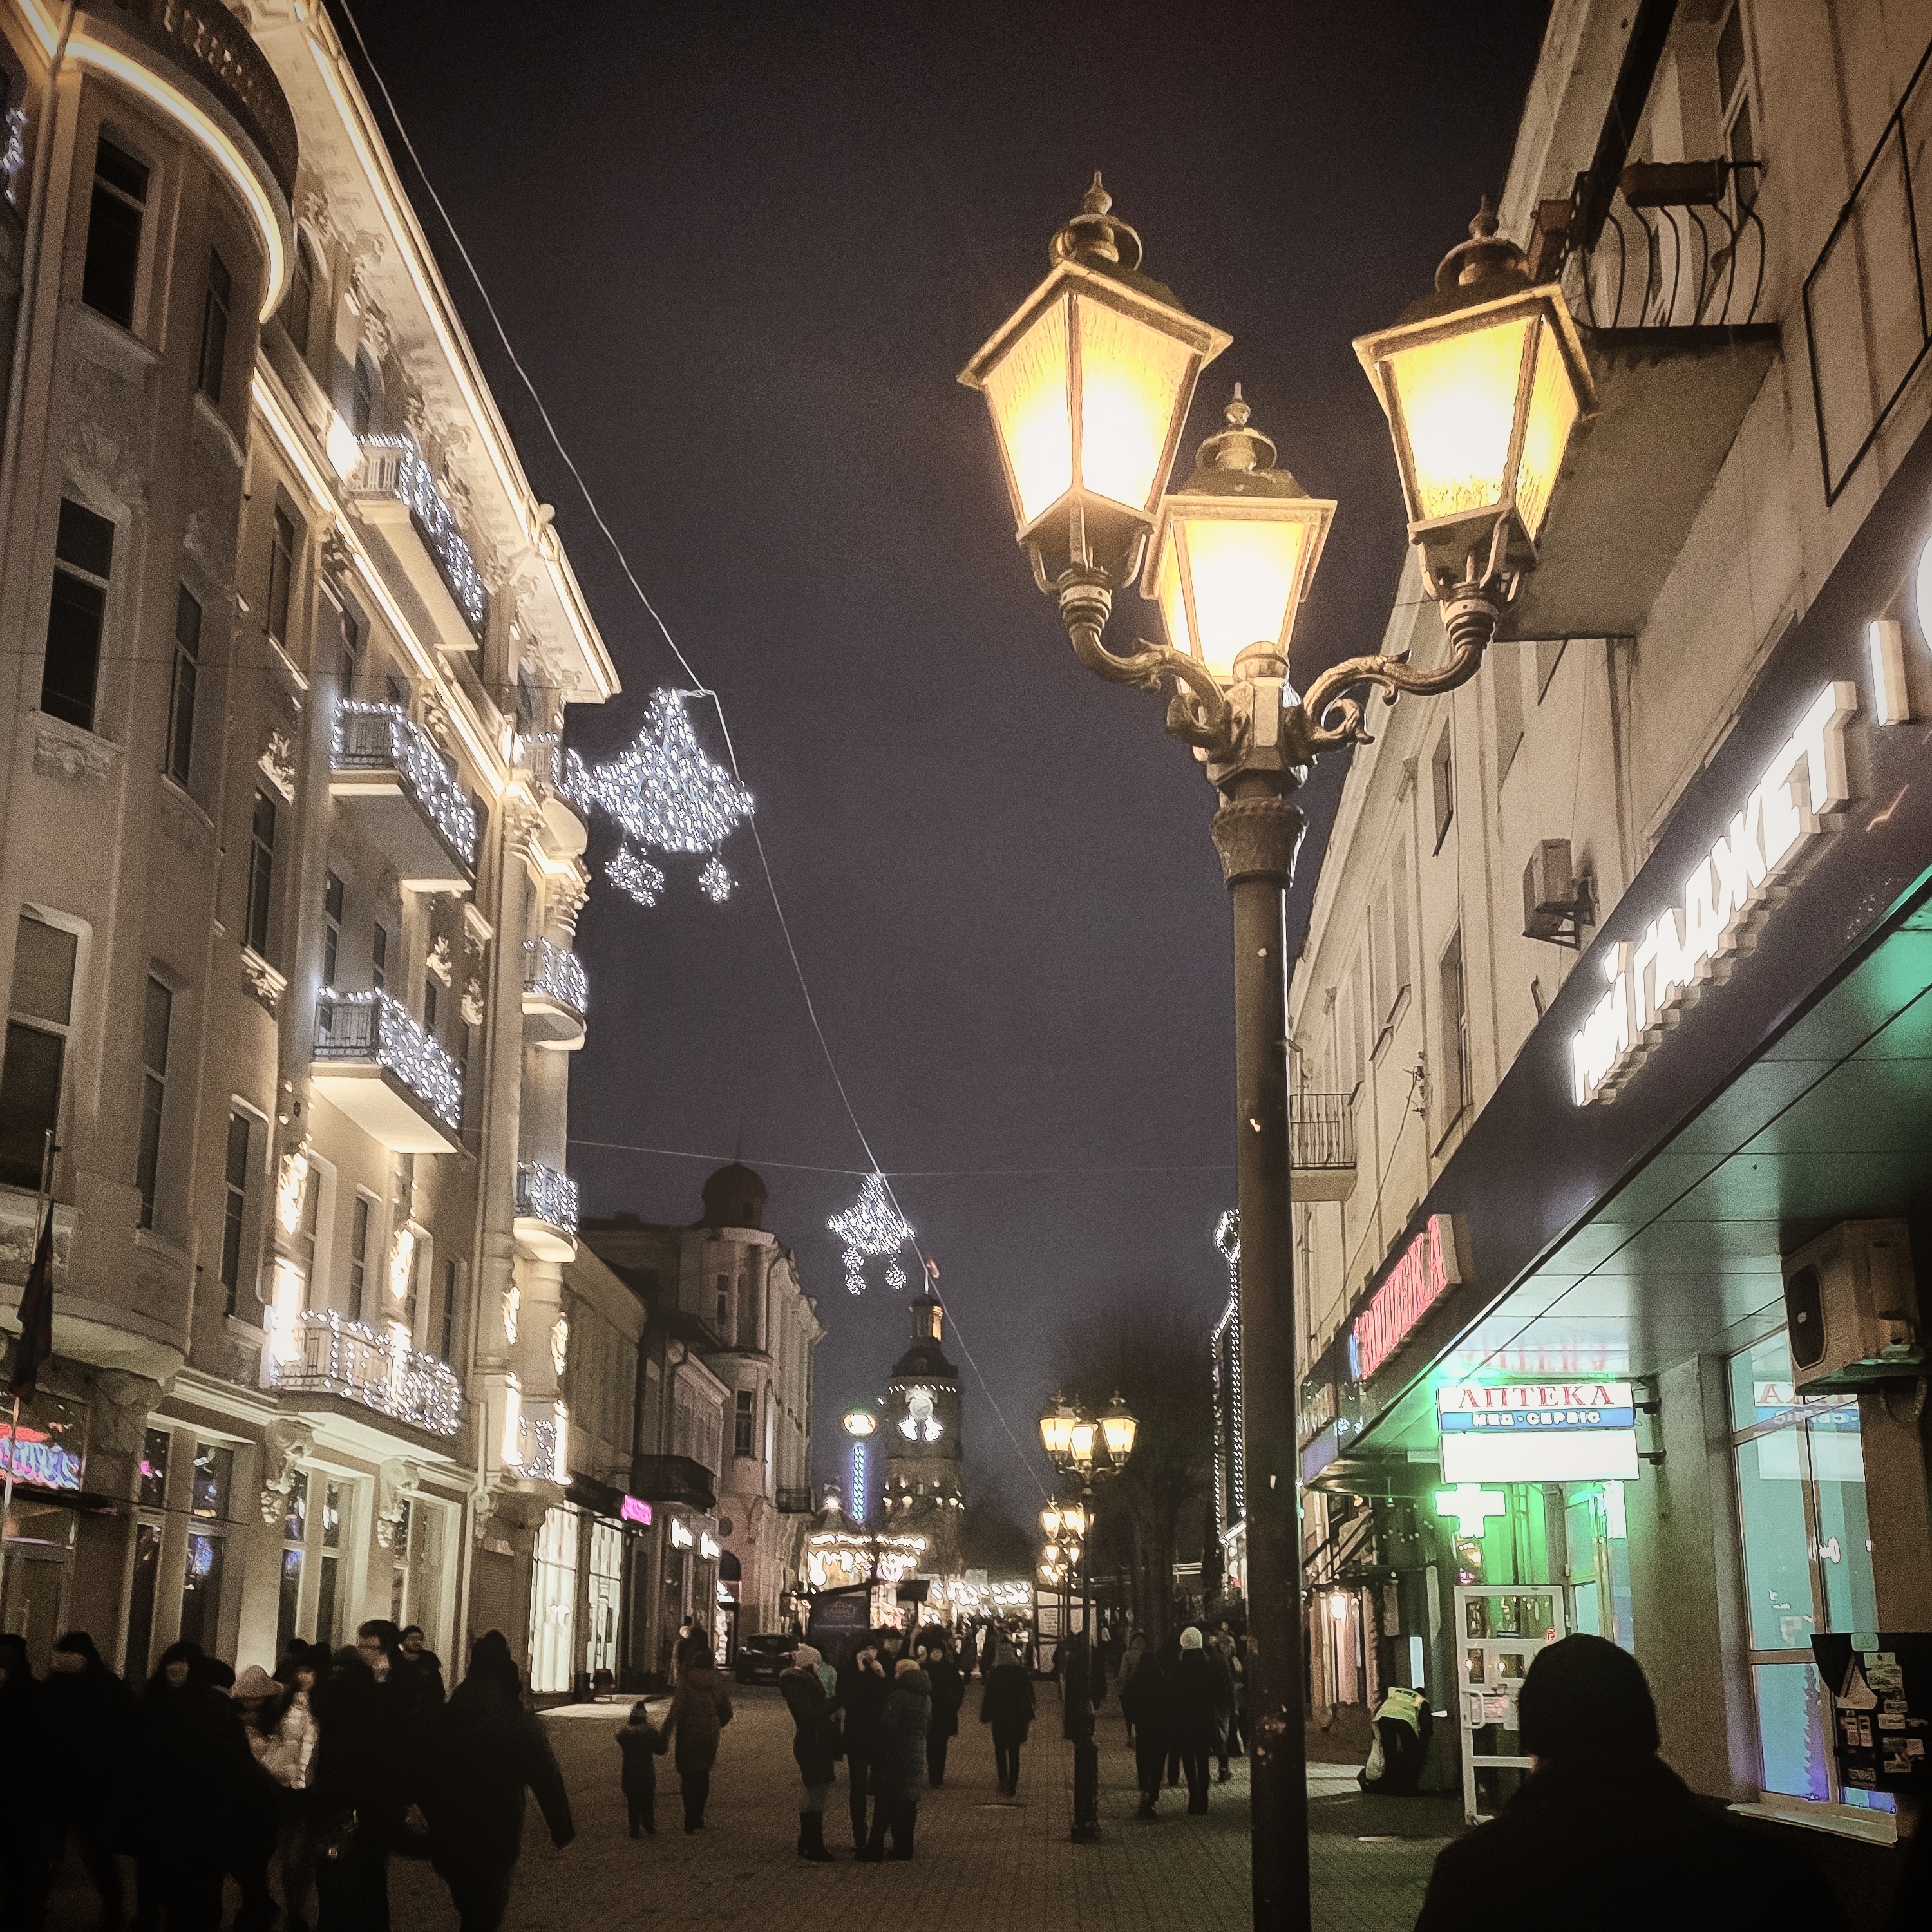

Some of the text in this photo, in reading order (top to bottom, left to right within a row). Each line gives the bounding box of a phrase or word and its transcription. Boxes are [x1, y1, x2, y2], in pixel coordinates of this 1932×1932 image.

[1633, 681, 1839, 1033] ГАДЖЕТ
[1361, 1214, 1448, 1380] АПТЕКА
[1458, 1385, 1615, 1408] АПТЕКА
